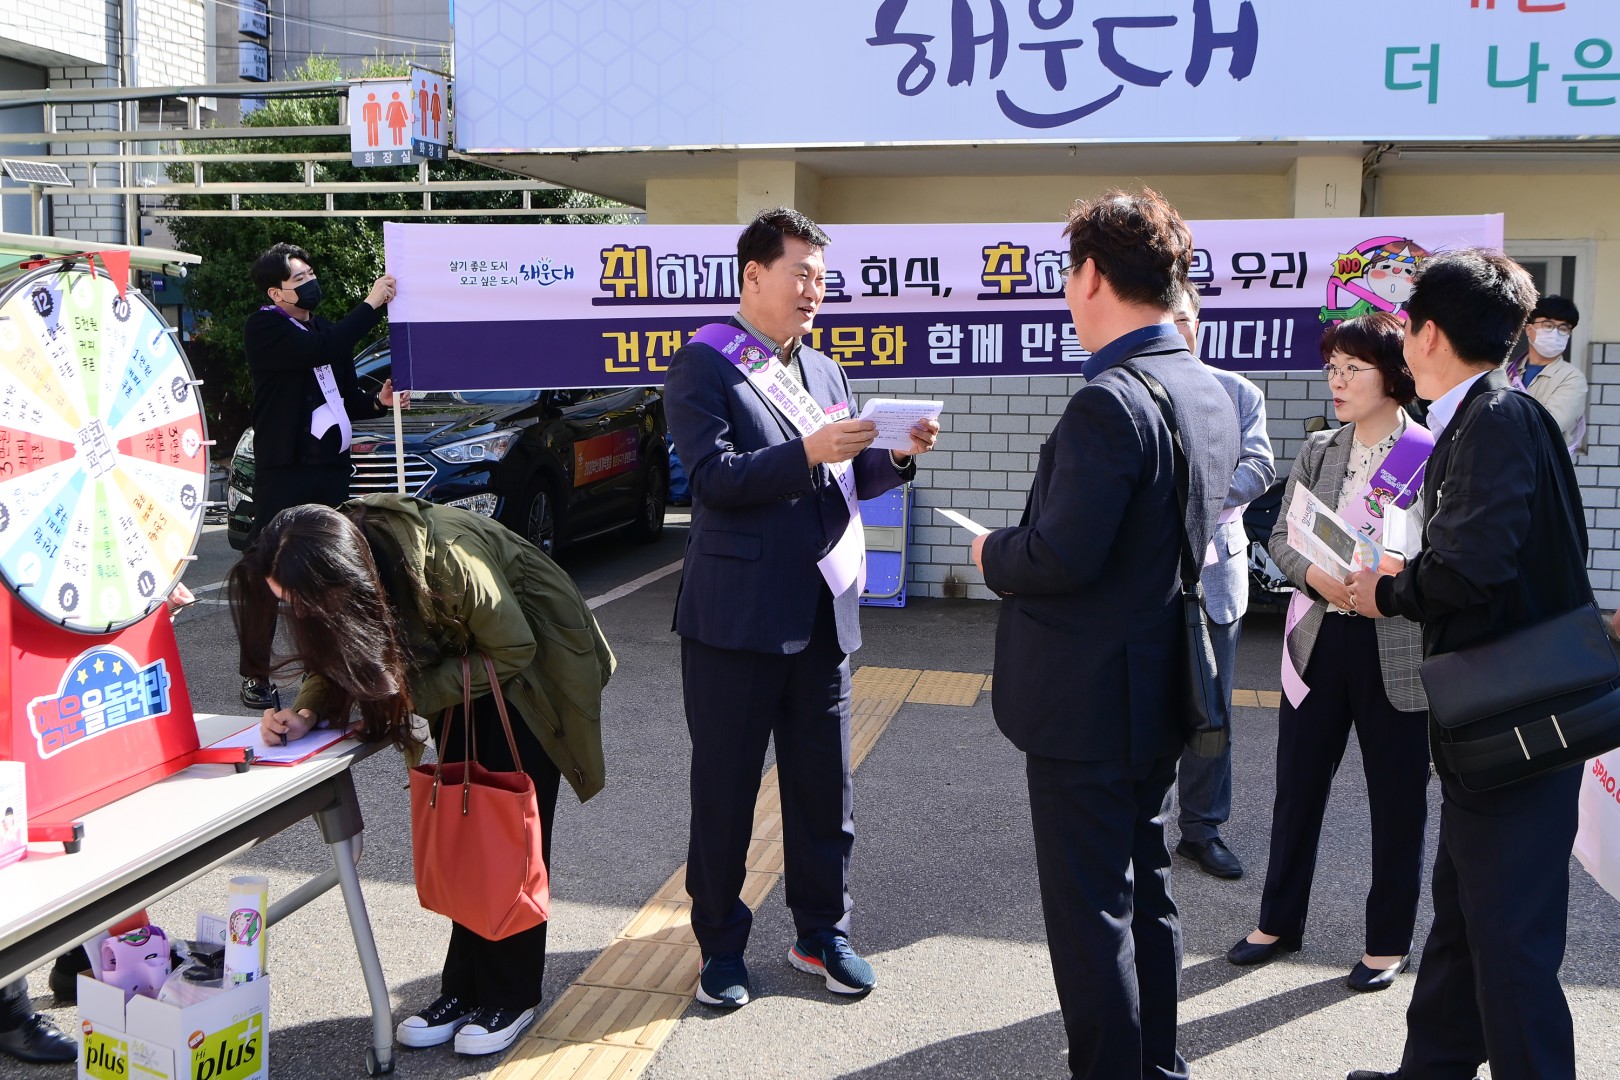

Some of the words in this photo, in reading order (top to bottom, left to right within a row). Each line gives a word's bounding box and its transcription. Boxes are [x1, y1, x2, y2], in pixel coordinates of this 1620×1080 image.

[1385, 44, 1440, 104] 더
[1487, 38, 1620, 107] 나은
[449, 260, 467, 272] 살기
[470, 261, 488, 272] 좋은
[490, 261, 508, 271] 도시
[519, 263, 574, 286] 해운대
[860, 256, 952, 298] 회식,
[983, 244, 1071, 294] 추하
[1231, 251, 1307, 289] 우리
[1338, 257, 1361, 275] NO
[460, 276, 478, 285] 오고
[480, 276, 498, 287] 싶은
[500, 276, 518, 285] 도시
[33, 292, 49, 312] 12
[74, 315, 98, 332] 5천원
[79, 338, 94, 350] 커피
[602, 329, 698, 372] 건전
[928, 323, 1003, 364] 함께
[1021, 323, 1093, 362] 만들
[1196, 319, 1294, 358] 시다!!
[81, 357, 95, 372] 쿠폰
[132, 349, 152, 378] 1만원
[128, 368, 141, 386] 커피
[121, 380, 132, 398] 쿠폰
[187, 439, 195, 447] 2
[181, 488, 194, 508] 13
[55, 504, 68, 525] 쿠폰
[46, 517, 62, 538] 커피
[33, 527, 58, 558] 1만원
[139, 572, 152, 594] 11
[86, 1043, 125, 1075] plus
[195, 1048, 206, 1061] Hi
[196, 1038, 257, 1080] plus
